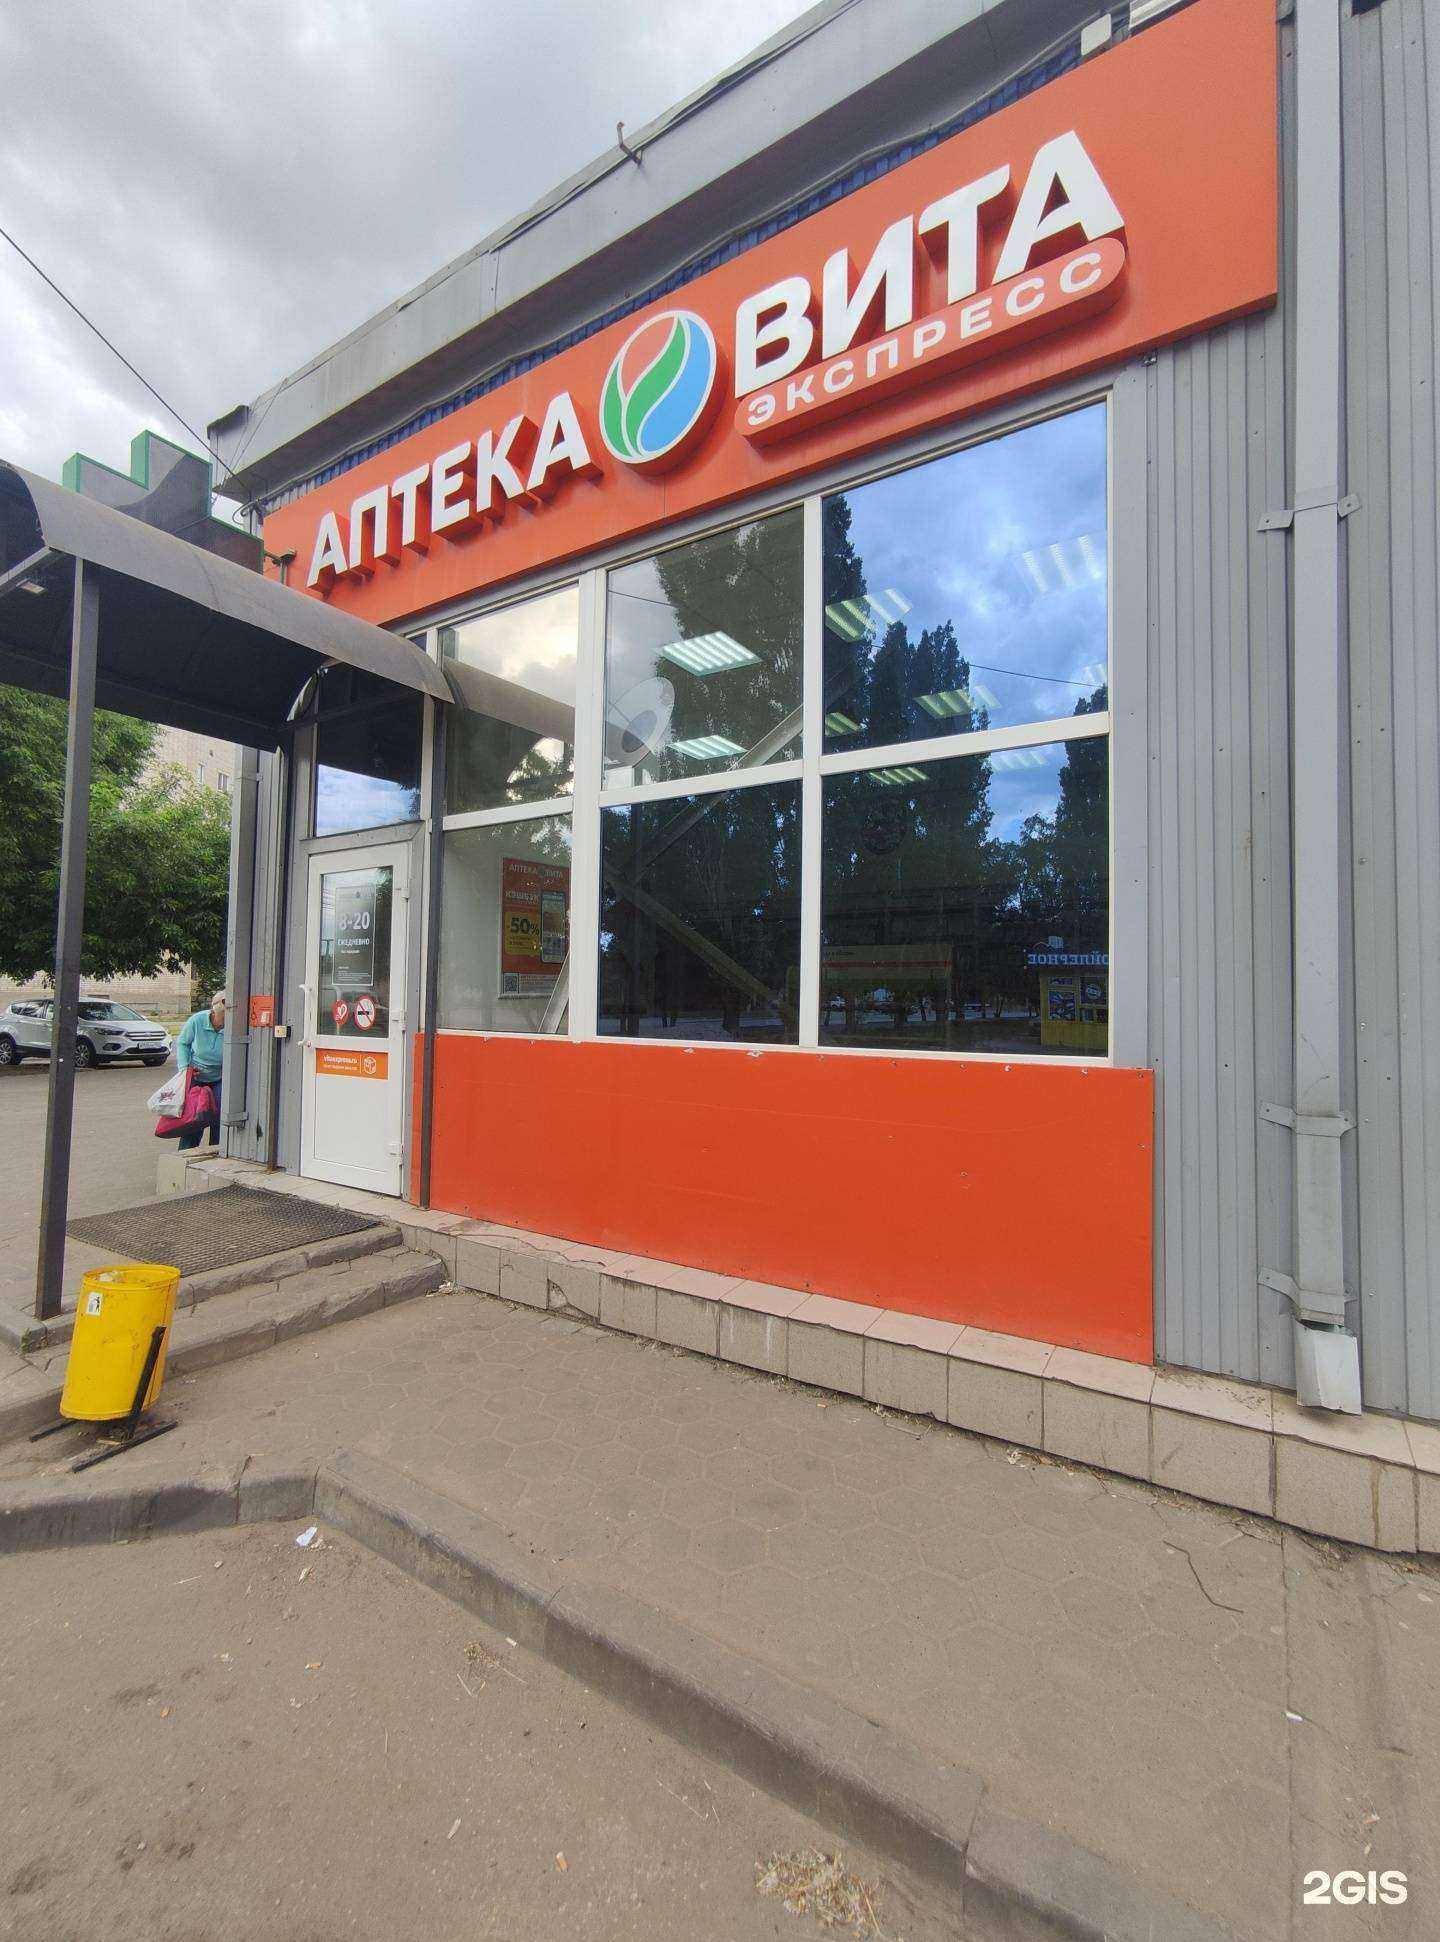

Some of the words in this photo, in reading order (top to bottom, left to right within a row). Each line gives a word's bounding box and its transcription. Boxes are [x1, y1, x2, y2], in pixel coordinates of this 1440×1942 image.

[307, 392, 591, 588] АПТЕКА
[735, 130, 1125, 399] ВИТА
[747, 252, 1102, 426] ЭКСПРЕСС
[339, 912, 370, 930] 8-20
